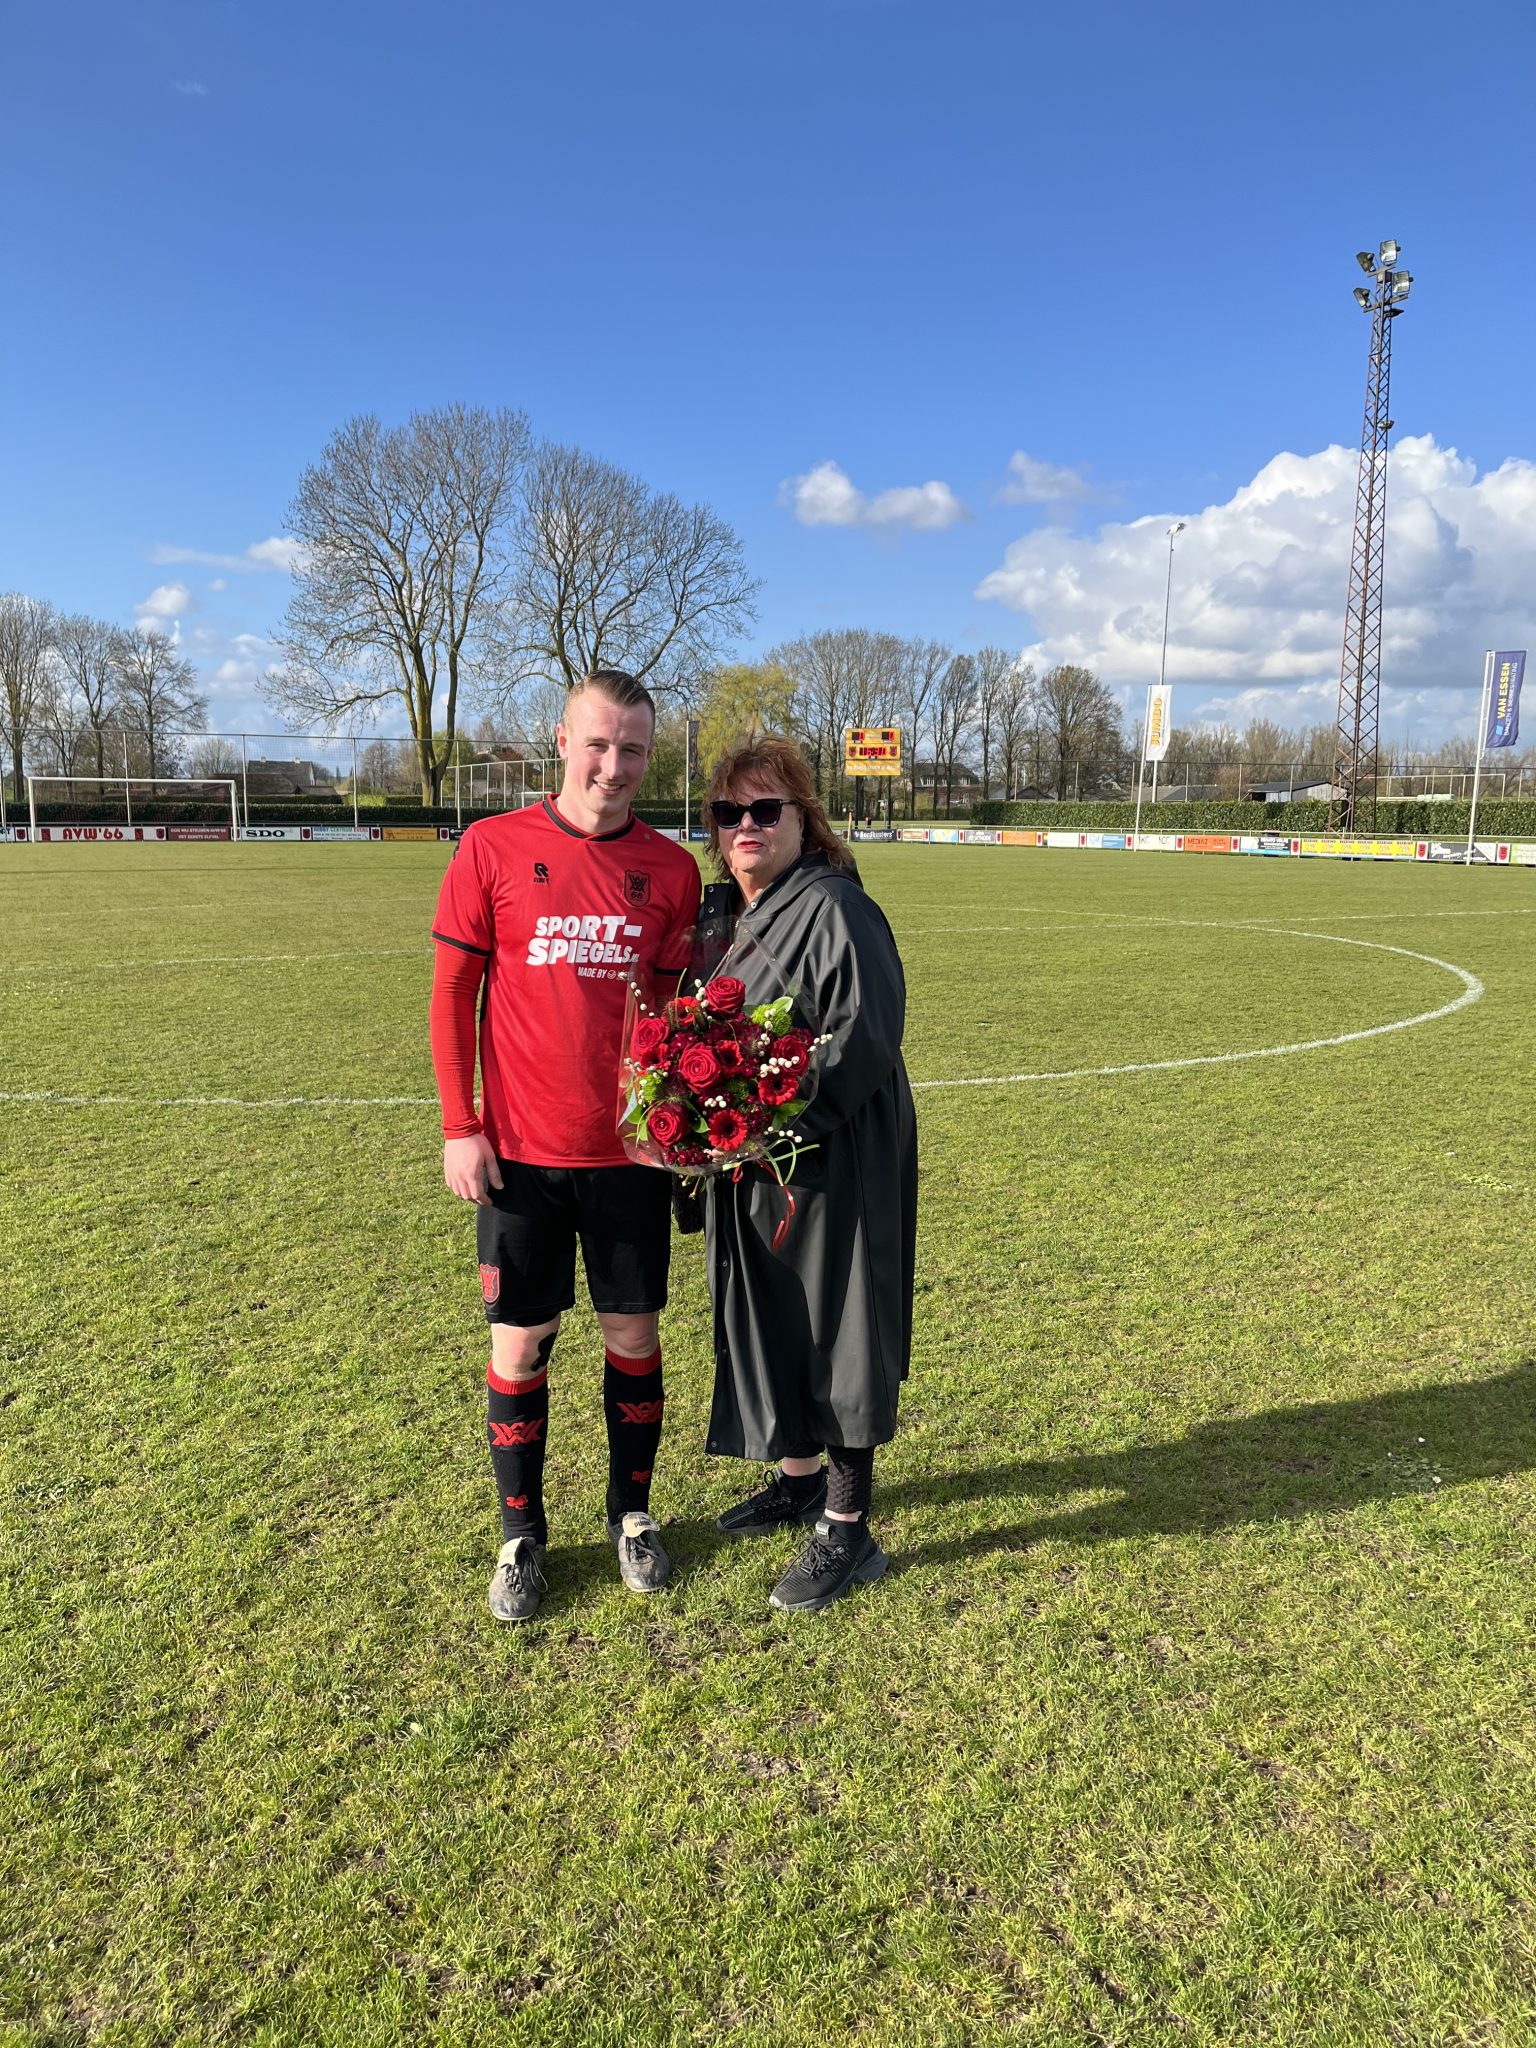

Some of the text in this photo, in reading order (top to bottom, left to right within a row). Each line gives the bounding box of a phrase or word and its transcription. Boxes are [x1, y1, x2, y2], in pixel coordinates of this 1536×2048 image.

[1497, 662, 1511, 718] VAN ESSEN
[63, 828, 123, 840] AVW'66
[246, 830, 285, 838] SDO
[534, 915, 642, 943] SPORT-
[578, 967, 597, 978] MADE
[597, 968, 607, 979] BY
